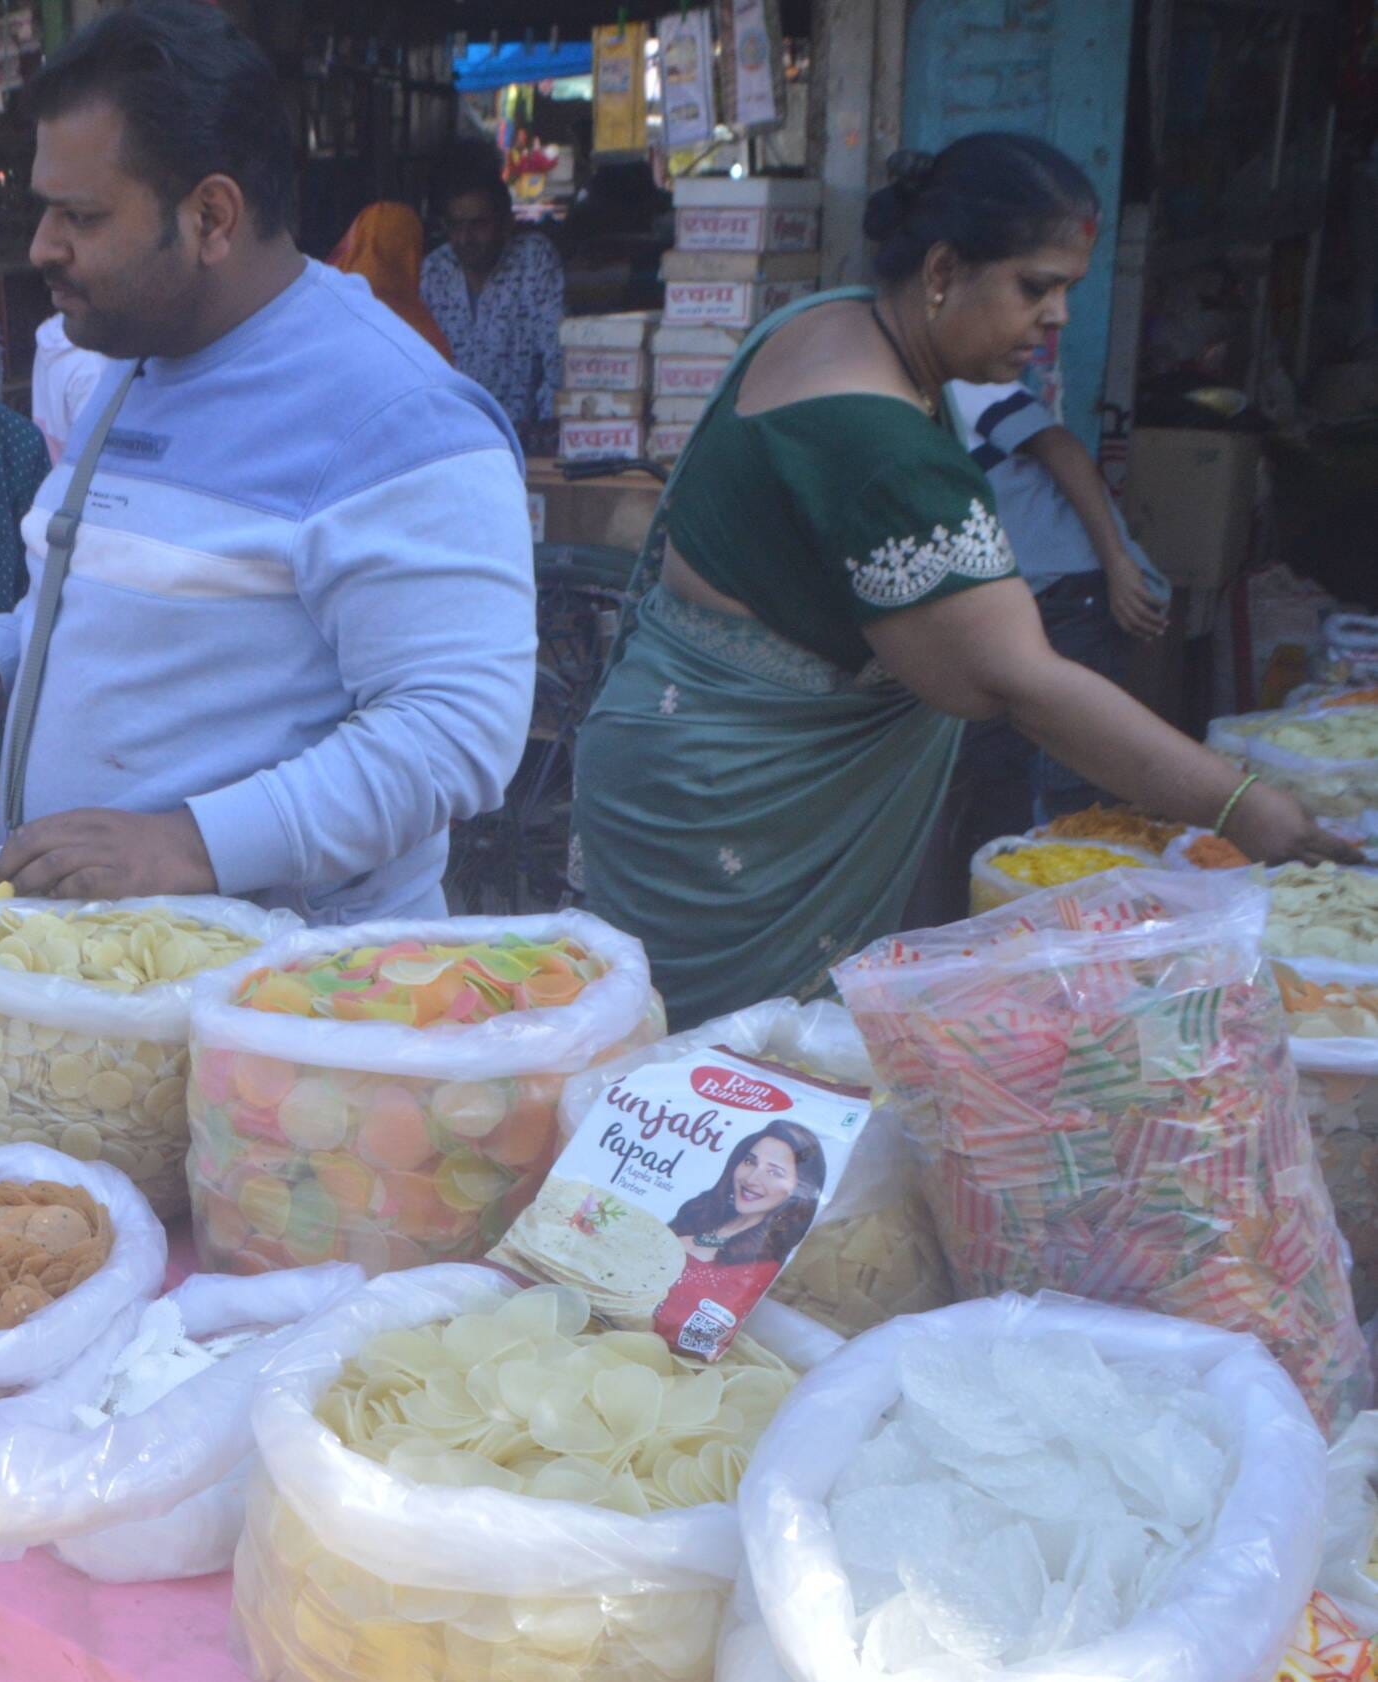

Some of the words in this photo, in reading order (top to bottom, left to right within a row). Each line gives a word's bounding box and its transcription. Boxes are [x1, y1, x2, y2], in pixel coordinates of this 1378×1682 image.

[566, 427, 634, 448] रचना
[698, 1077, 774, 1111] Bandhu
[724, 1074, 771, 1097] Ram
[607, 1076, 733, 1152] unjabi
[599, 1122, 685, 1184] Papad
[616, 1176, 648, 1197] Partner
[624, 1164, 652, 1184] Aapka
[653, 1177, 675, 1193] Taste
